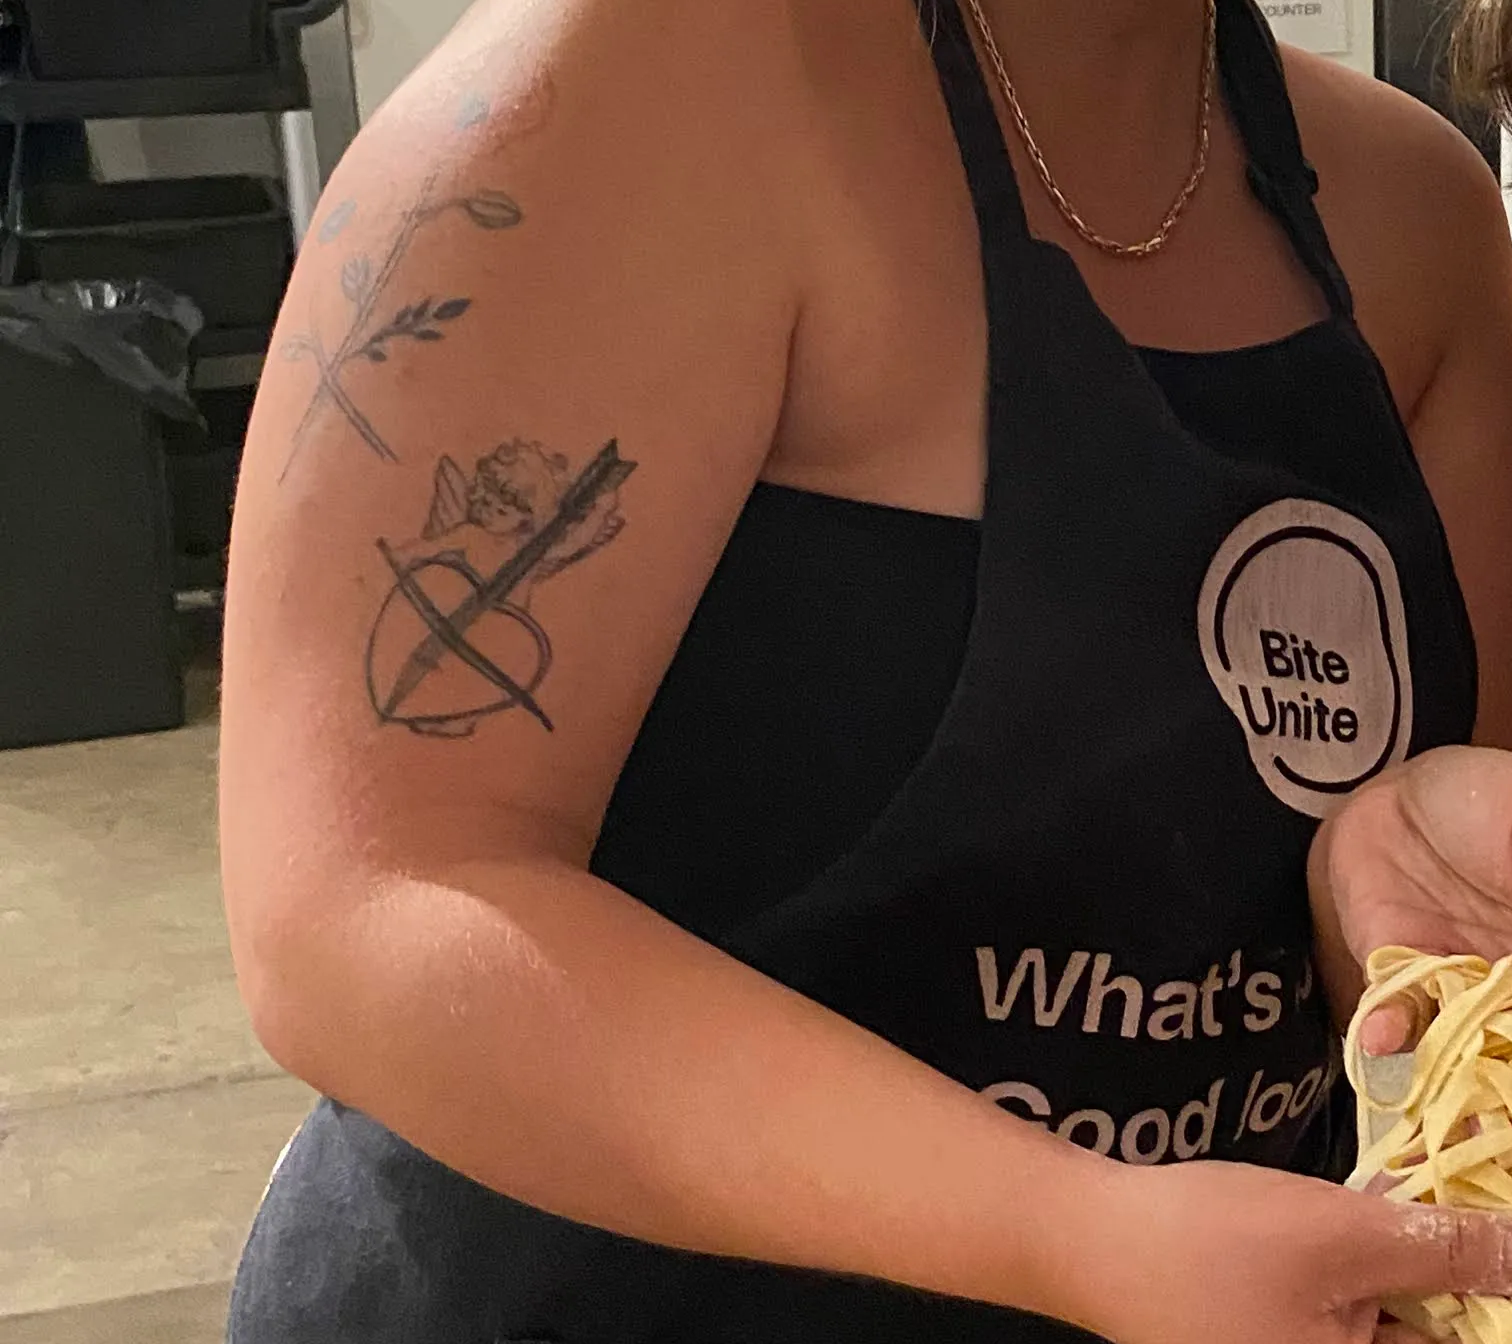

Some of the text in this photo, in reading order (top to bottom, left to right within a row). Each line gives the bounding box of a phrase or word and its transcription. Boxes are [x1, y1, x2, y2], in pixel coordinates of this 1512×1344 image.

[1260, 629, 1349, 685] Bite
[1238, 684, 1358, 743] Unite
[975, 946, 1282, 1040] What's
